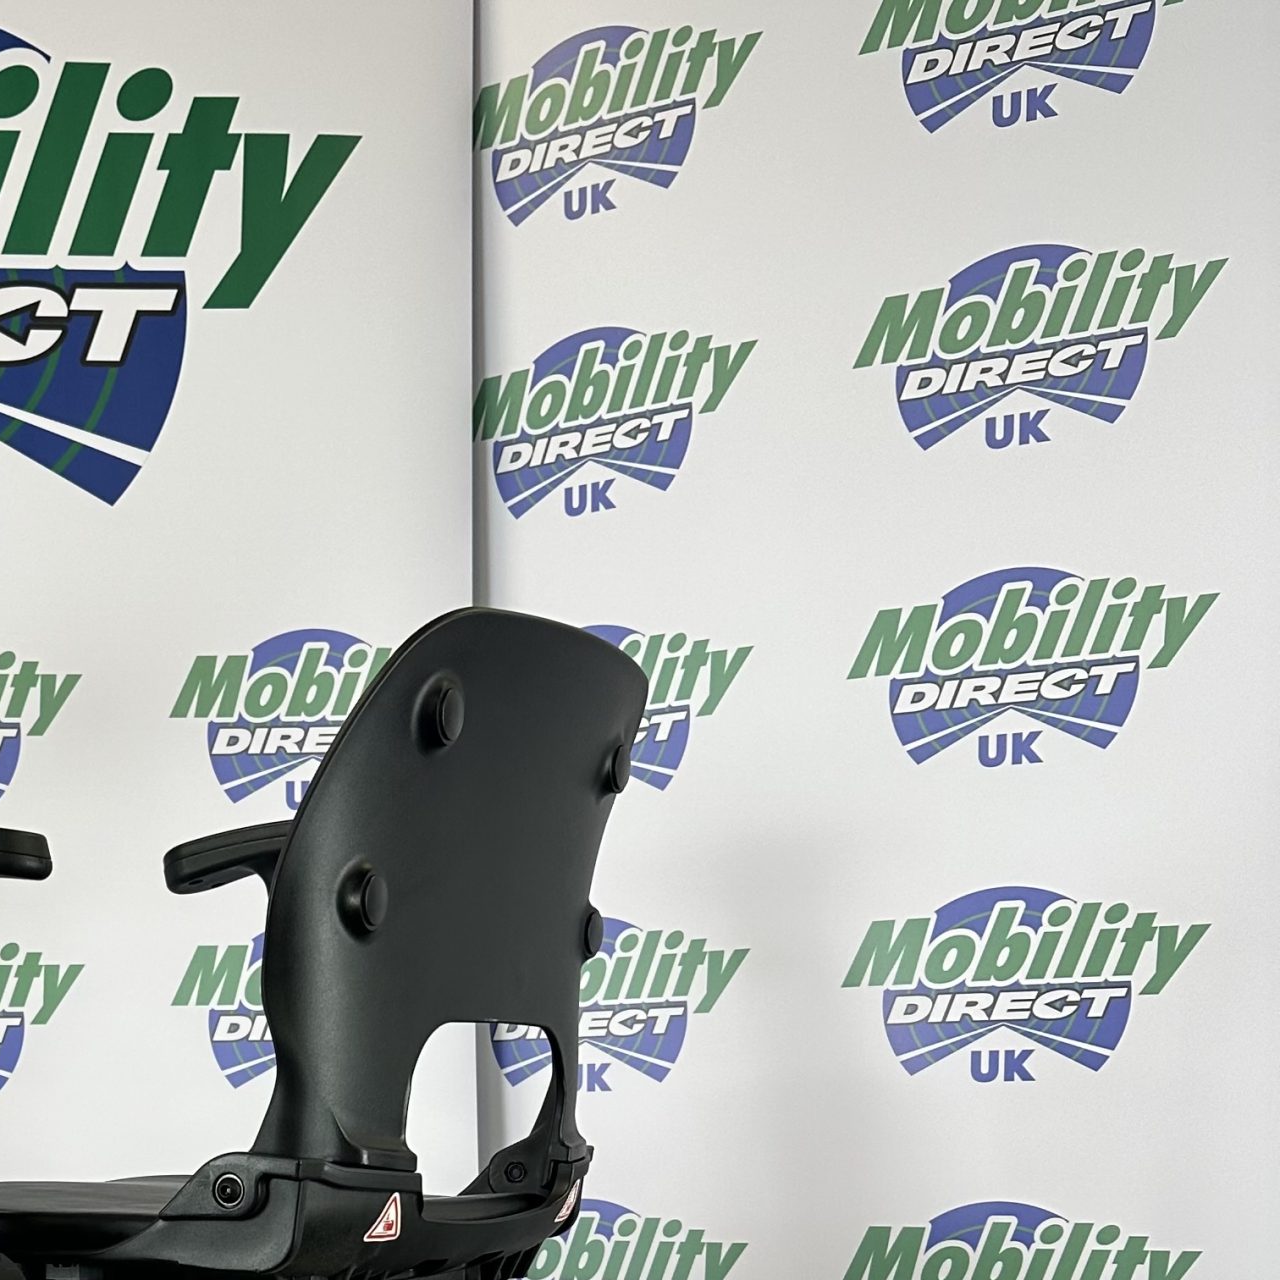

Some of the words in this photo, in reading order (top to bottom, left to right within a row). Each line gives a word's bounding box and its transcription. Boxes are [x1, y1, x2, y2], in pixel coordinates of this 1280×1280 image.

[907, 1, 1154, 85] DIRECT
[473, 25, 764, 151] Mobility
[992, 83, 1058, 128] UK
[496, 105, 693, 183] DIRECT
[564, 178, 617, 221] UK
[852, 248, 1229, 370] Mobility
[472, 329, 759, 442] Mobility
[900, 334, 1145, 401] DIRECT
[496, 408, 689, 475] DIRECT
[985, 408, 1051, 450] UK
[564, 478, 616, 517] UK
[847, 577, 1220, 680] Mobility
[893, 662, 1135, 714] DIRECT
[211, 726, 342, 755] DIRE
[978, 731, 1043, 768] UK
[842, 902, 1212, 996] Mobility
[886, 987, 1130, 1025] DIRECT
[970, 1048, 1036, 1083] UK
